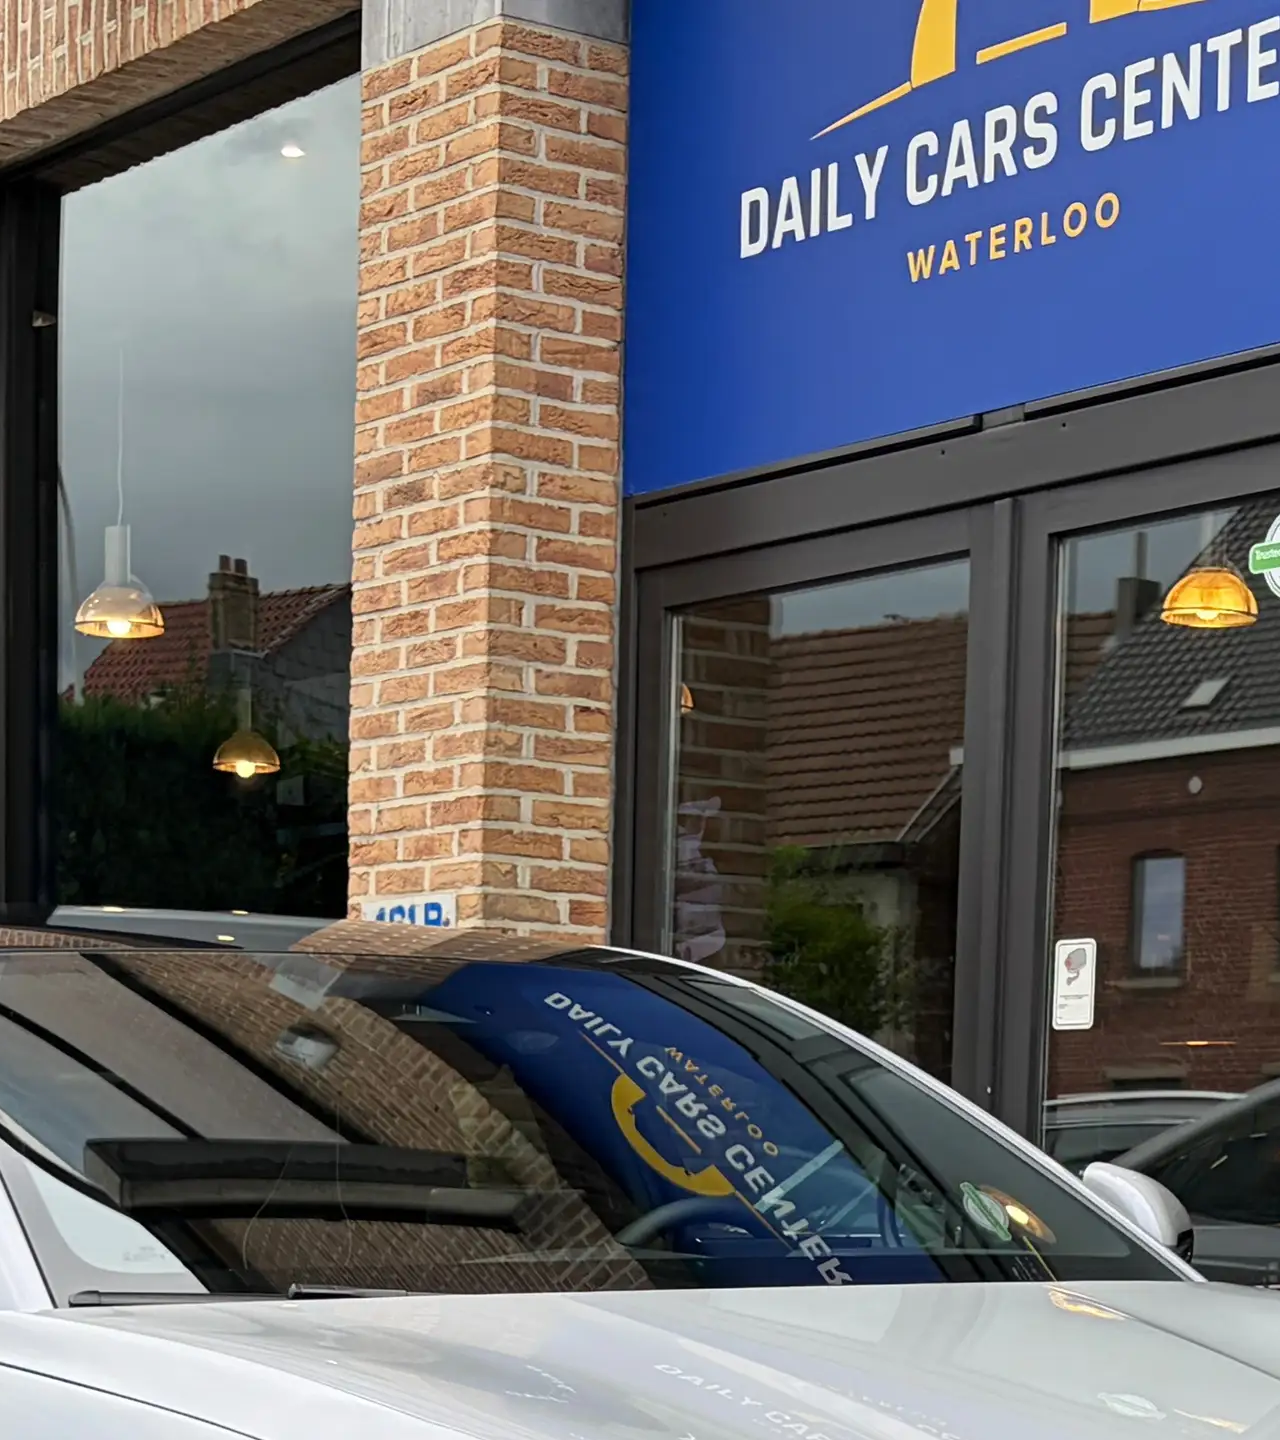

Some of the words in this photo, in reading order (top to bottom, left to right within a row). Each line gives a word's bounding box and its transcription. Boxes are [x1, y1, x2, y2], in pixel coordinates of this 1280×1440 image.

[740, 145, 890, 259] DAILY
[906, 92, 1058, 206] CARS
[907, 192, 1121, 283] WATERLOO
